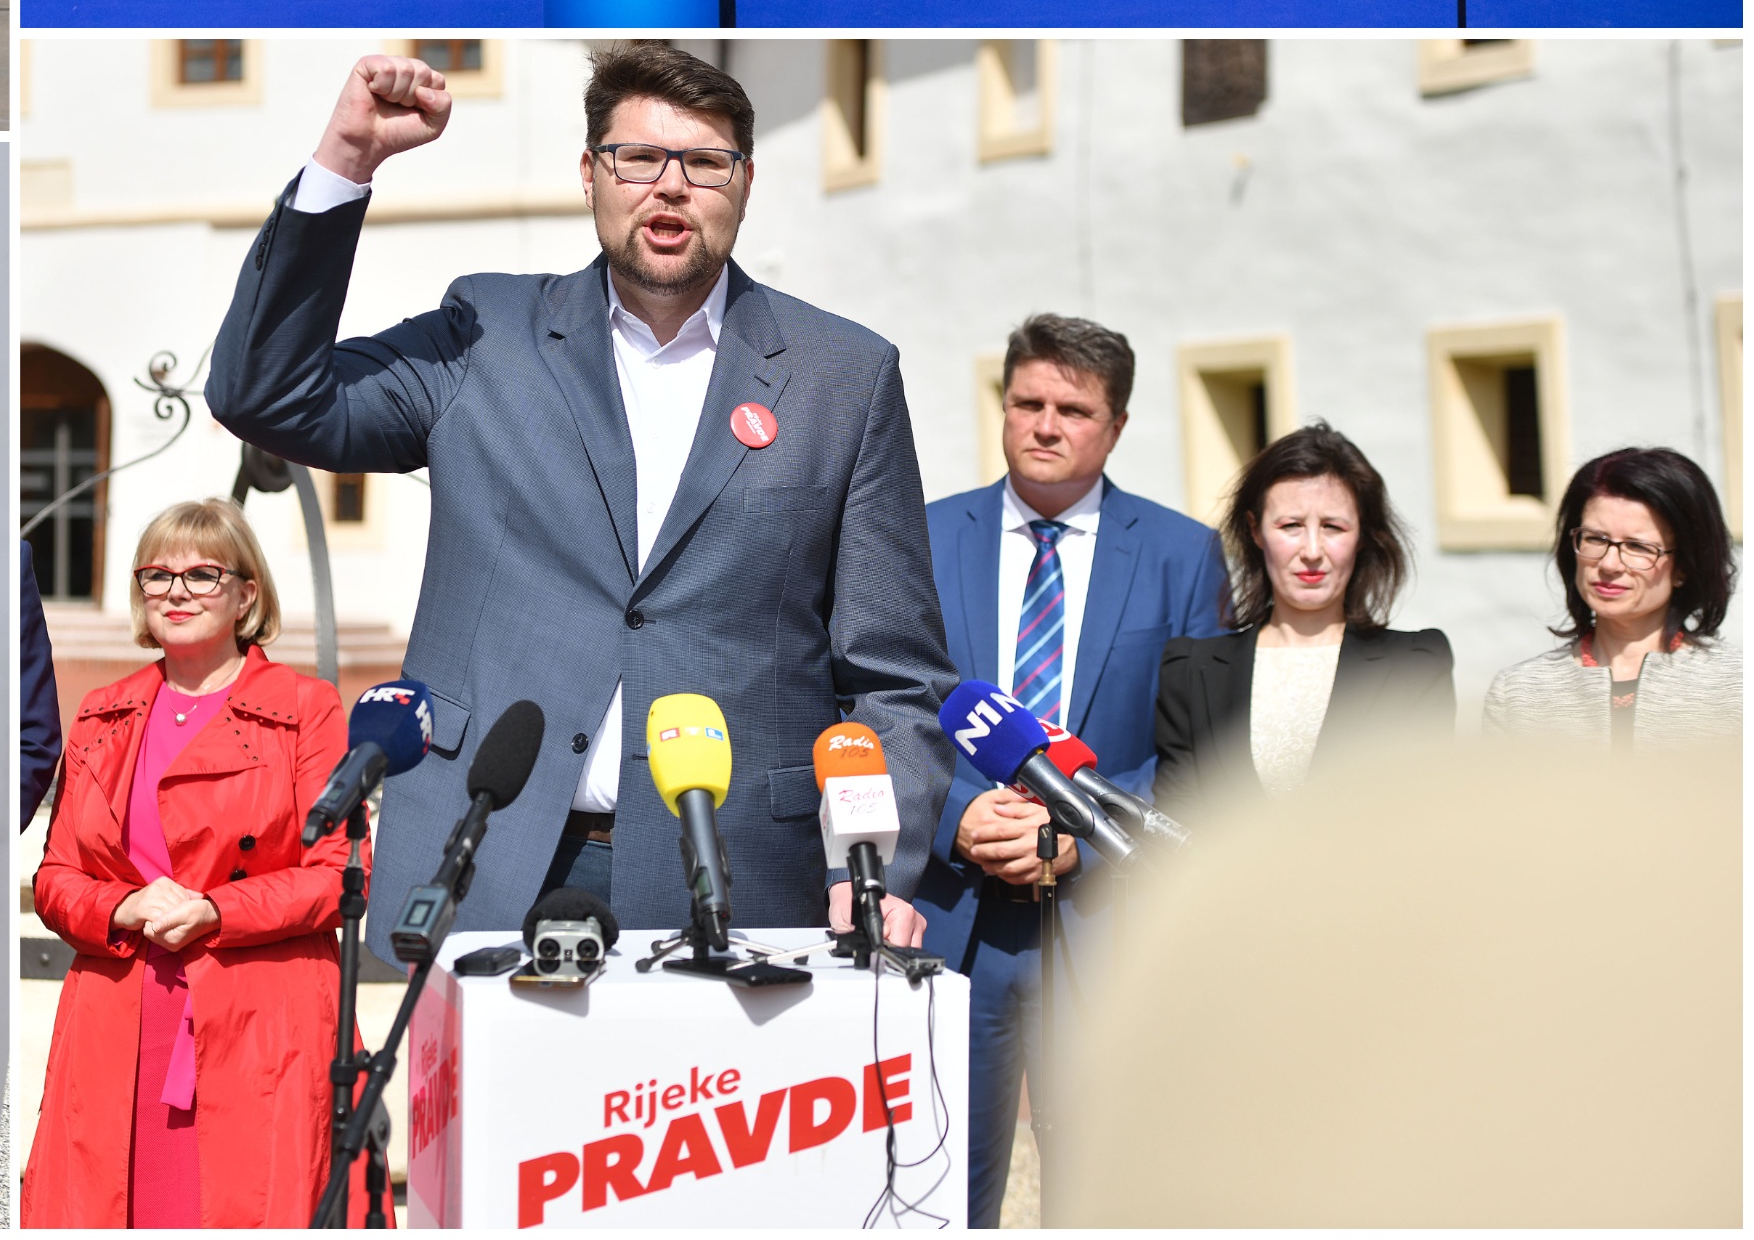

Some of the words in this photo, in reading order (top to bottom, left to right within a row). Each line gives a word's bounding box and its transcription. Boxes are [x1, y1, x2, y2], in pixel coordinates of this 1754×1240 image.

[360, 687, 416, 705] HRT
[660, 727, 724, 742] RTL
[955, 700, 1003, 756] N1
[828, 735, 874, 752] Radio
[840, 747, 870, 759] 105
[839, 787, 885, 804] Radio
[604, 1066, 741, 1129] Rijeke
[518, 1053, 913, 1229] PRAVDE
